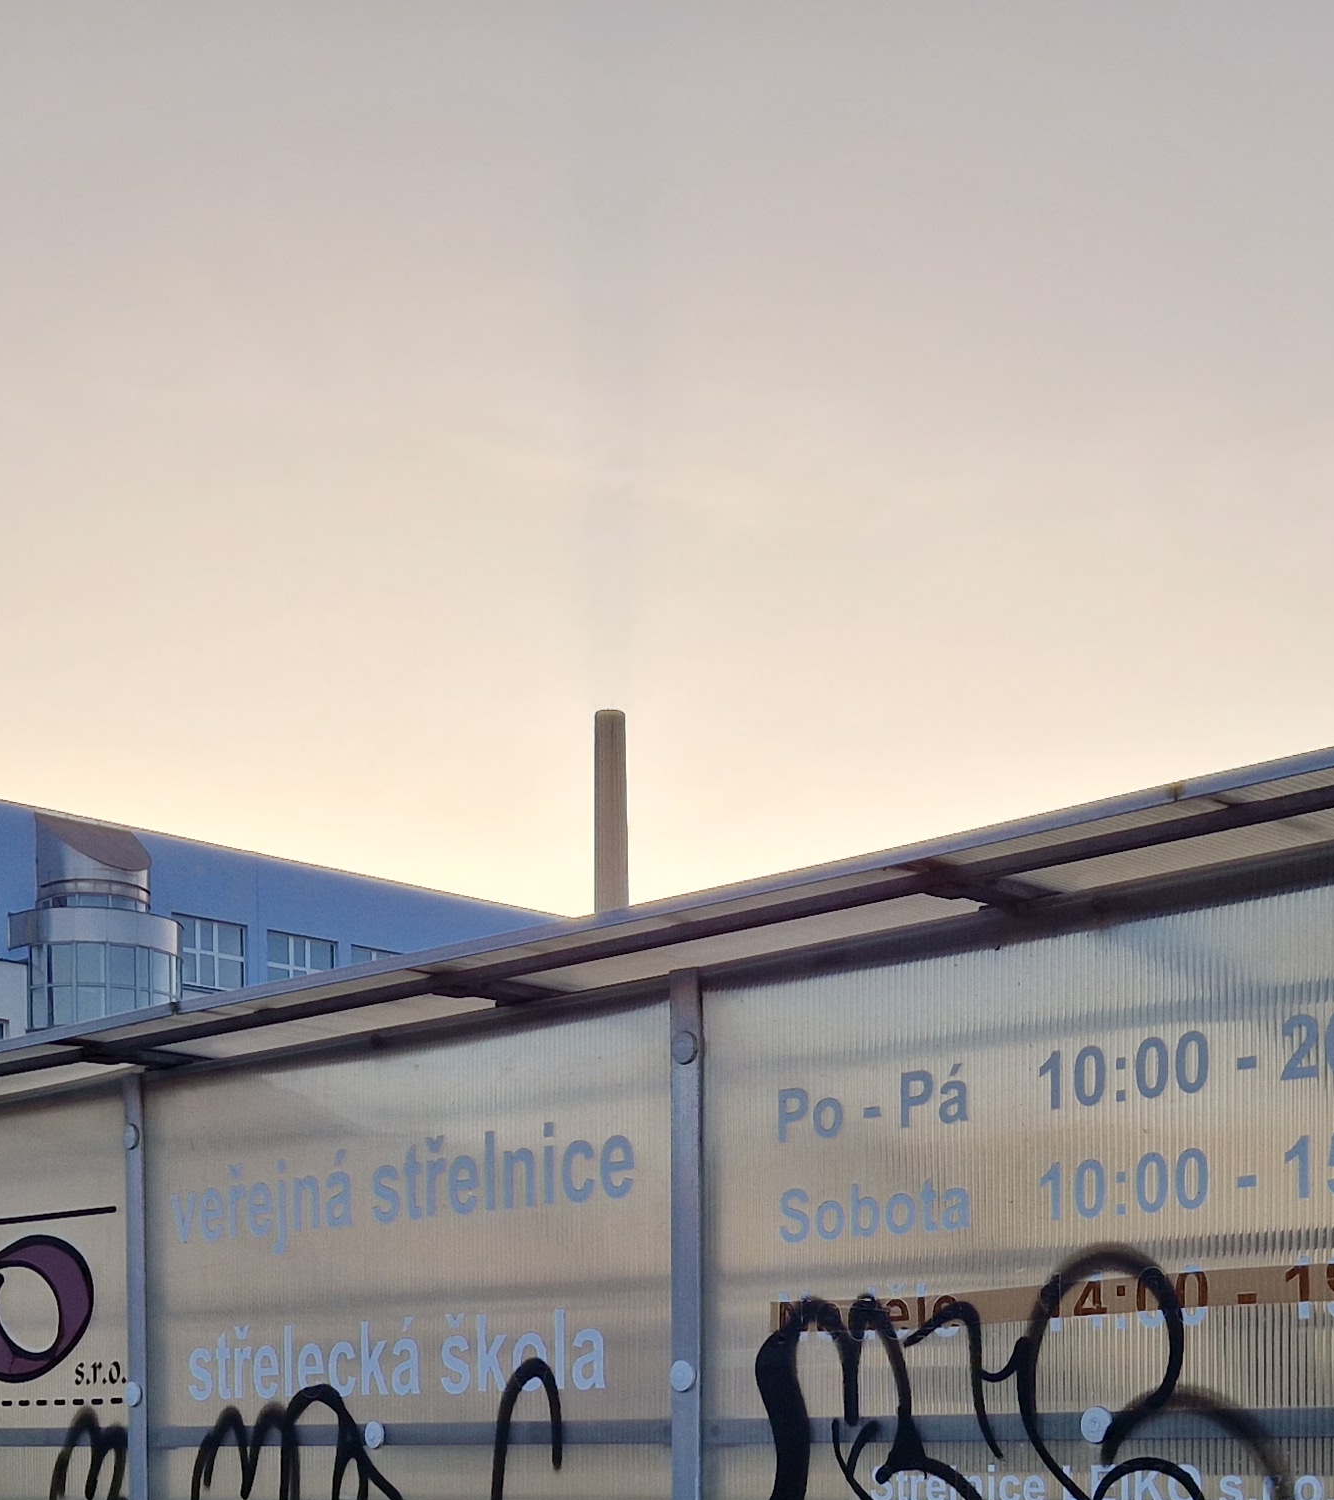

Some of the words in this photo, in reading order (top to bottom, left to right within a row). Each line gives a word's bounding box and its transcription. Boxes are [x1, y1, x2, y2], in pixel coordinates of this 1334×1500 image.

[778, 1088, 843, 1142] Po
[863, 1107, 881, 1120] -
[899, 1063, 969, 1129] Pá
[1038, 1031, 1210, 1111] 10:00
[1236, 1055, 1258, 1071] -
[171, 1149, 352, 1254] veřejná
[372, 1122, 635, 1223] střelnice
[779, 1178, 971, 1244] Sobota
[1038, 1147, 1210, 1222] 10:00
[1236, 1174, 1258, 1190] -
[74, 1361, 127, 1387] s.r.o.
[188, 1316, 421, 1400] střelecká
[440, 1308, 607, 1396] škola
